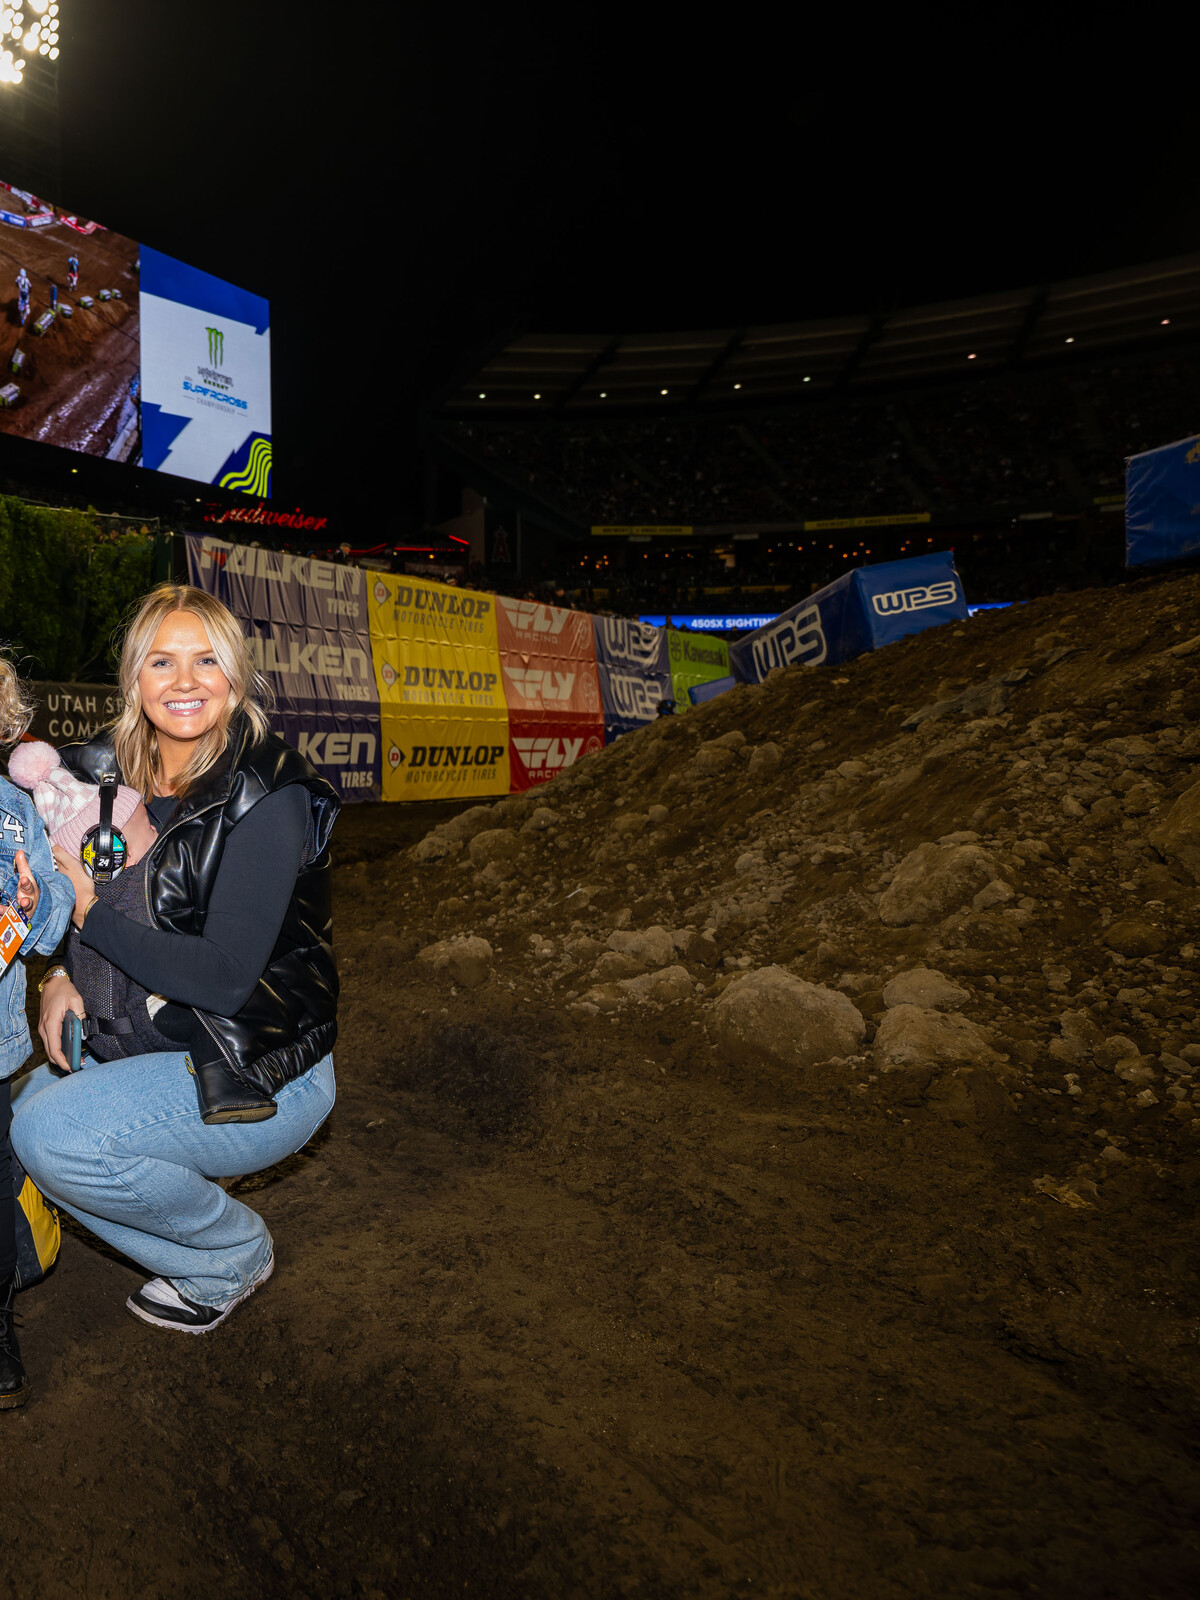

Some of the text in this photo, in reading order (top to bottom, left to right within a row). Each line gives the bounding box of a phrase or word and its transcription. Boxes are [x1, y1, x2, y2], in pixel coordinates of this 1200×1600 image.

[182, 381, 248, 409] SUPERCROSS
[199, 535, 364, 595] FALKEN
[327, 598, 360, 617] TIRES
[395, 585, 491, 619] DUNLOP
[872, 581, 958, 616] WPS
[393, 608, 484, 633] MOTORCYCLE TIRES
[499, 598, 572, 634] FLY
[691, 616, 775, 629] 450SX SIGHTIN
[515, 631, 559, 645] RACING
[751, 604, 828, 684] WPS
[682, 640, 728, 668] Kawasaki
[403, 665, 498, 692] DUNLOP
[503, 666, 576, 701] FLY
[47, 693, 97, 713] UTAH
[336, 683, 370, 701] TIRES
[403, 690, 494, 706] MOTORCYCLE TIRES
[525, 700, 568, 712] RACING
[409, 746, 504, 768] DUNLOP
[511, 737, 585, 769] FLY
[340, 770, 374, 788] TIRES
[405, 767, 496, 785] MOTORCYCLE TIRES
[98, 858, 110, 867] 24
